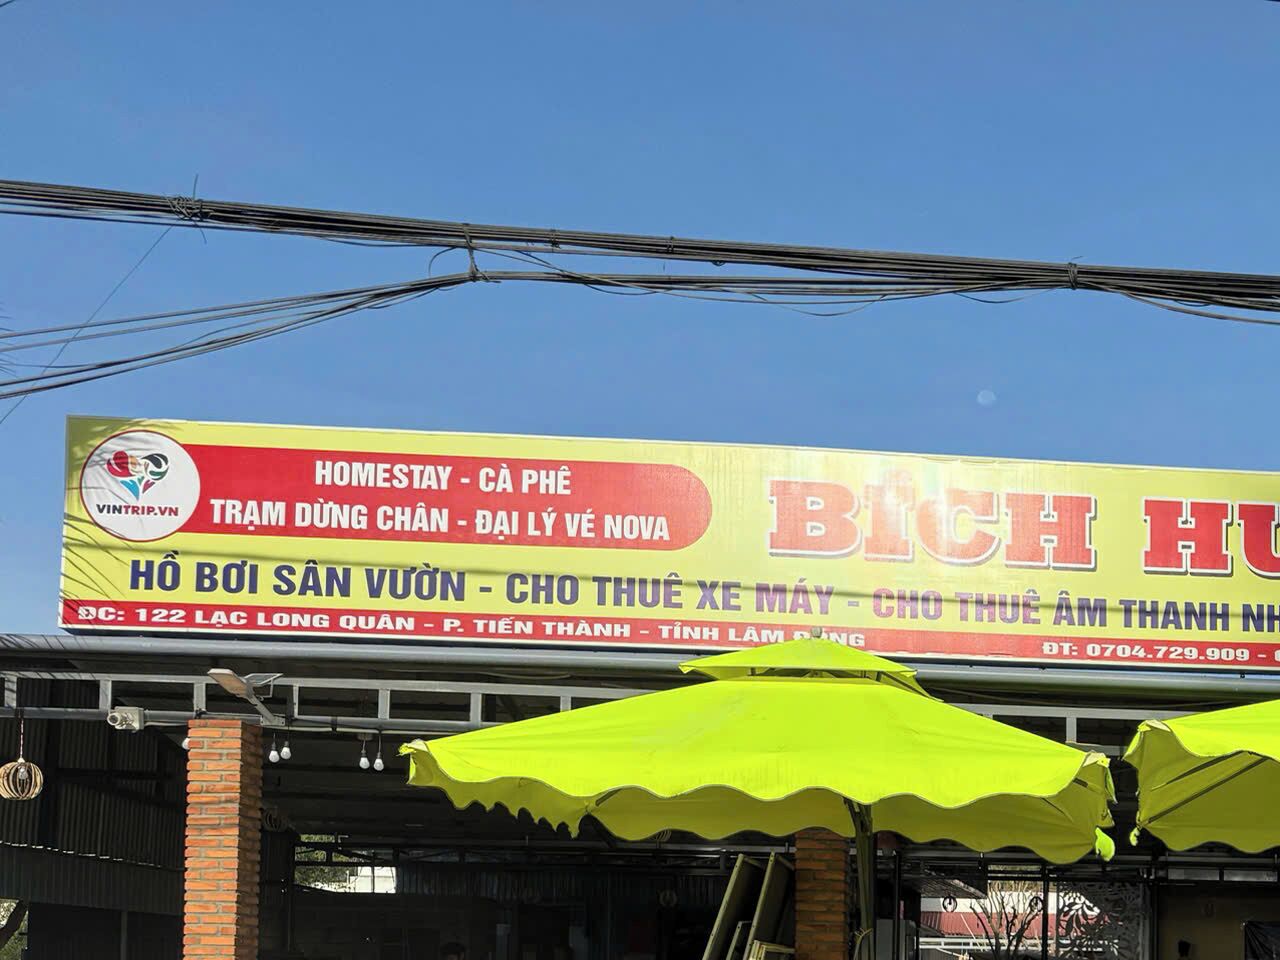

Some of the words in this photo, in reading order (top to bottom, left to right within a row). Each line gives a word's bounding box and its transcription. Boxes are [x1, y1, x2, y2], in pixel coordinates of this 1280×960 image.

[315, 460, 452, 490] HOMESTAY
[479, 464, 513, 493] CÀ
[522, 466, 571, 495] PHÊ
[96, 503, 179, 517] VINTRIP.VN
[210, 499, 286, 531] TRẠM
[295, 497, 368, 530] DỪNG
[377, 503, 448, 533] CHÂN
[475, 510, 518, 540] ĐẠI
[528, 507, 557, 537] LÝ
[564, 509, 595, 538] VÉ
[604, 515, 670, 540] NOVA
[769, 470, 1096, 570] BÍCH
[129, 550, 181, 591] HỒ
[195, 560, 258, 594] BƠI
[273, 559, 350, 598] SÂN
[365, 563, 466, 601] VƯỜN
[506, 572, 579, 606] CHO
[592, 572, 683, 608] THUÊ
[696, 580, 741, 611] XE
[755, 578, 834, 615] MÁY
[872, 587, 943, 620] CHO
[954, 589, 1040, 624] THUÊ
[1053, 590, 1106, 627] ÂM
[1119, 599, 1229, 632] THANH
[78, 606, 125, 621] ĐC:
[135, 608, 186, 623] 122
[195, 610, 248, 628] LẠC
[257, 614, 329, 628] LONG
[339, 613, 415, 631] QUÂN
[443, 619, 464, 633] P.
[473, 616, 533, 635] TIẾN
[542, 619, 630, 638] THÀNH
[658, 622, 720, 641] TỈNH
[728, 626, 784, 643] LÂM
[792, 627, 865, 647] ĐNG
[1042, 641, 1078, 655] ĐT:
[1086, 643, 1250, 661] 0704.729.909
